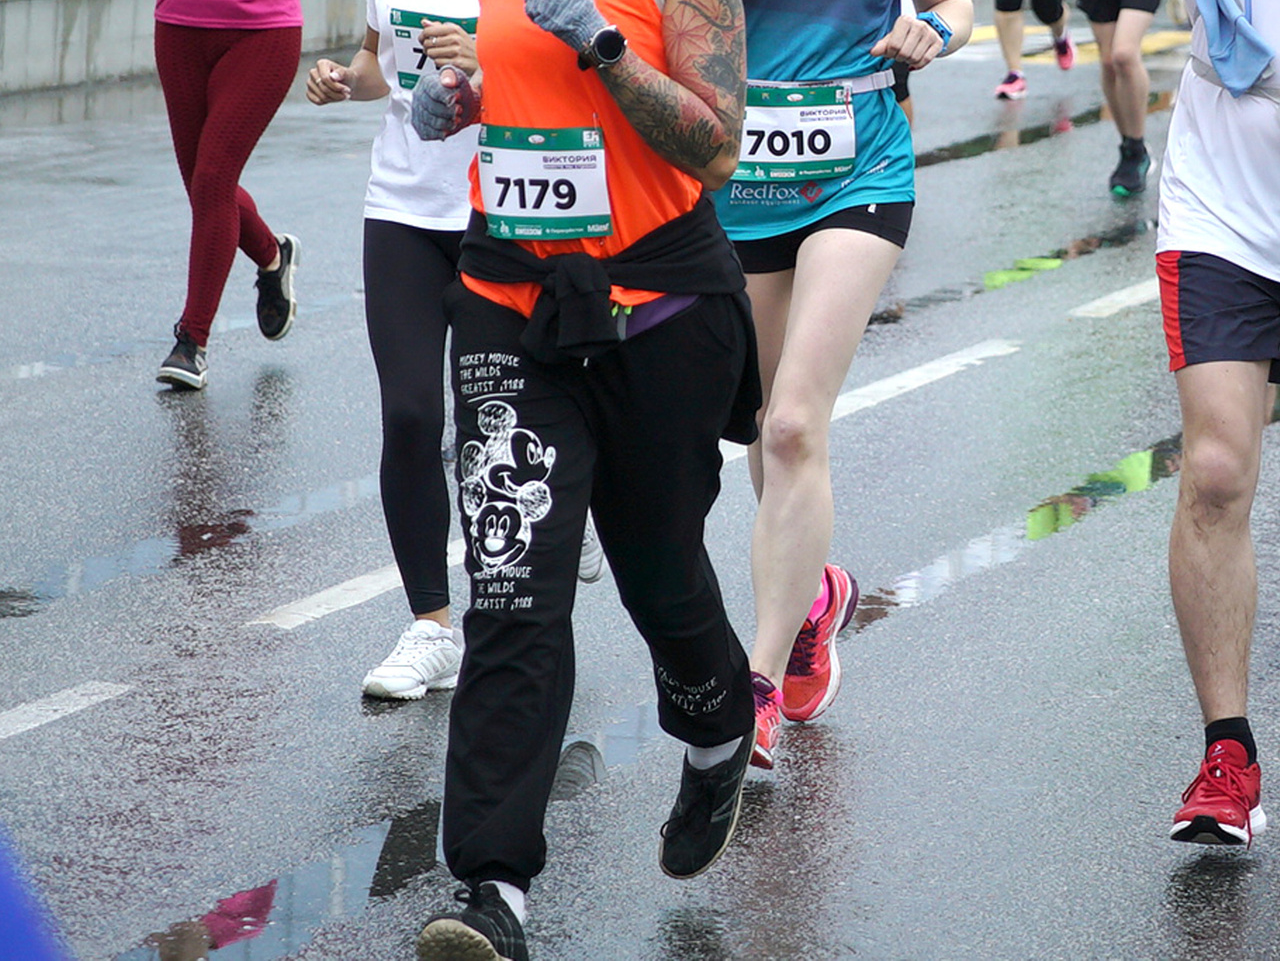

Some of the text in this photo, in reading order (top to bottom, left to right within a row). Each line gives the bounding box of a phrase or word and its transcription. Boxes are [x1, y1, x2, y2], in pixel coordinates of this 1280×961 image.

[746, 128, 831, 156] 7010
[542, 155, 597, 163] ВИКТОРИЯ
[495, 176, 577, 210] 7179
[487, 353, 520, 367] MOUSE
[460, 366, 501, 380] THE WILDS
[501, 566, 532, 578] MOUSE
[487, 581, 515, 594] WILDS
